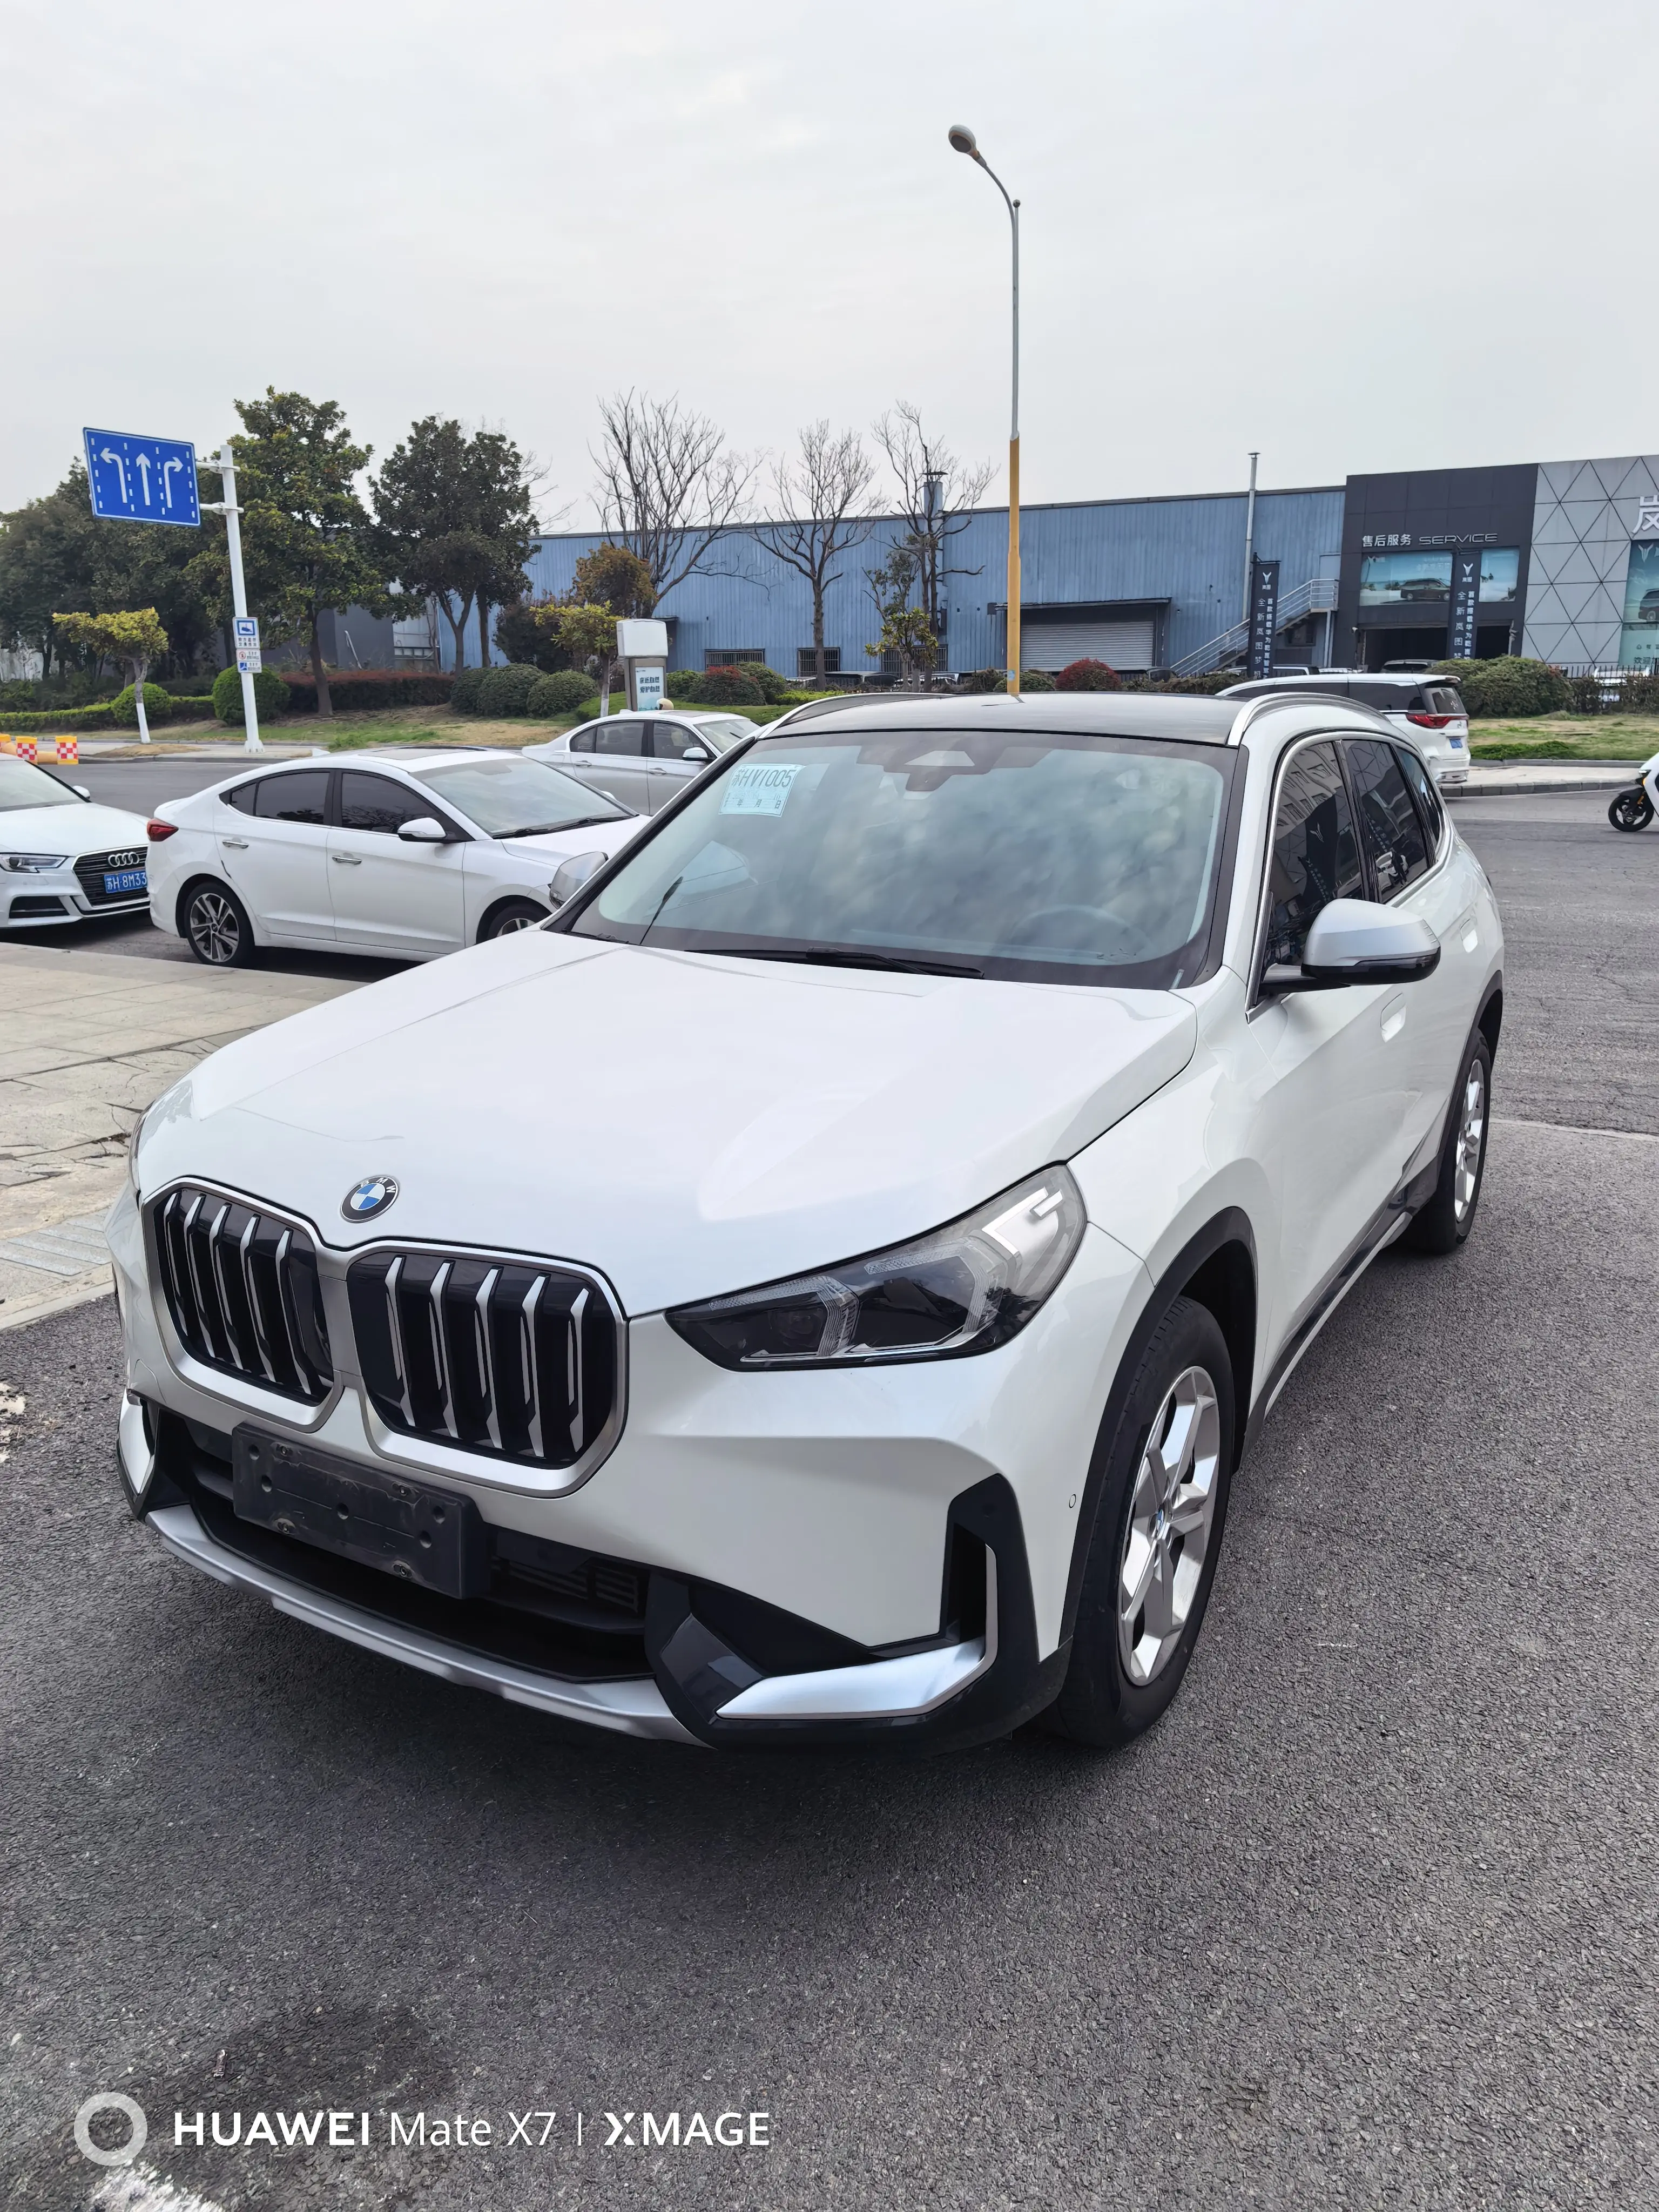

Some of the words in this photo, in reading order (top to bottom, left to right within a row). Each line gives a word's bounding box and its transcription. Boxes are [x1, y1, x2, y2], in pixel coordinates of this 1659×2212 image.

[1363, 534, 1412, 547] 售后服务
[1419, 533, 1498, 545] SERVICE
[360, 1177, 396, 1193] BMW
